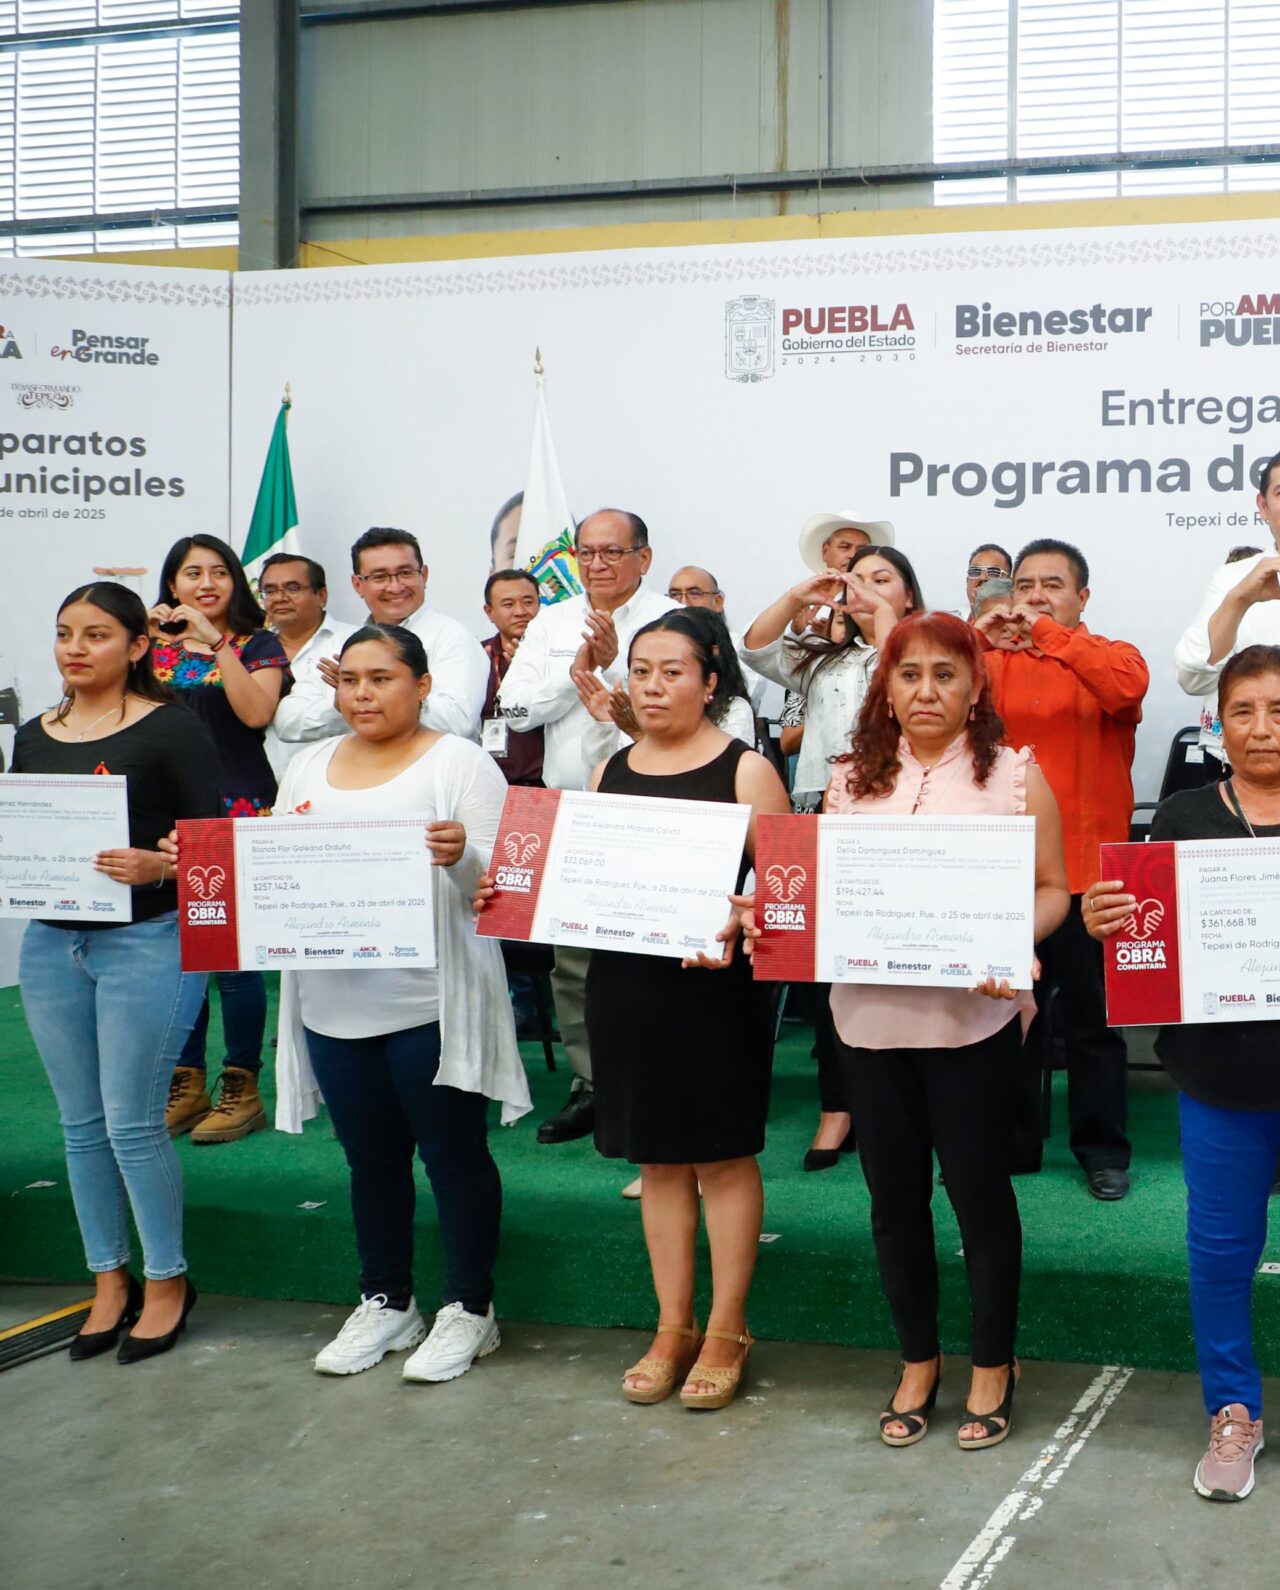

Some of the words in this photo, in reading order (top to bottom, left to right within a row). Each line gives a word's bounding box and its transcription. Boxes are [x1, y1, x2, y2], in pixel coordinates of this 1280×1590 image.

[782, 303, 915, 335] PUEBLA
[955, 302, 1152, 338] Bienestar
[72, 329, 149, 350] Pensar
[782, 337, 843, 352] Gobierno
[845, 336, 866, 349] del
[868, 334, 916, 348] Estado
[955, 342, 1023, 356] Secretaría
[1024, 341, 1043, 354] de
[1046, 339, 1109, 353] Bienestar
[51, 345, 78, 361] en
[75, 345, 160, 366] Grande
[889, 451, 1192, 509] Programa
[18, 508, 48, 519] abril
[52, 508, 70, 520] de
[73, 508, 106, 520] 2025
[1165, 512, 1221, 531] Tepexi
[1226, 512, 1249, 527] de
[497, 865, 534, 876] PROGRAMA
[495, 872, 532, 888] OBRA
[1199, 874, 1228, 884] Juana
[1230, 873, 1257, 882] Flores
[9, 898, 46, 907] Bienestar
[187, 900, 226, 908] PROGRAMA
[764, 902, 806, 911] PROGRAMA
[187, 907, 227, 920] OBRA
[763, 910, 806, 925] OBRA
[561, 921, 589, 931] PUEBLA
[595, 926, 635, 938] Bienestar
[1115, 940, 1166, 950] PROGRAMA
[267, 947, 297, 956] PUEBLA
[304, 947, 344, 956] Bienestar
[1116, 947, 1167, 963] OBRA
[847, 958, 879, 968] PUEBLA
[887, 960, 932, 971] Bienestar
[1117, 961, 1167, 971] COMUNITARIA
[1219, 993, 1256, 1003] PUEBLA
